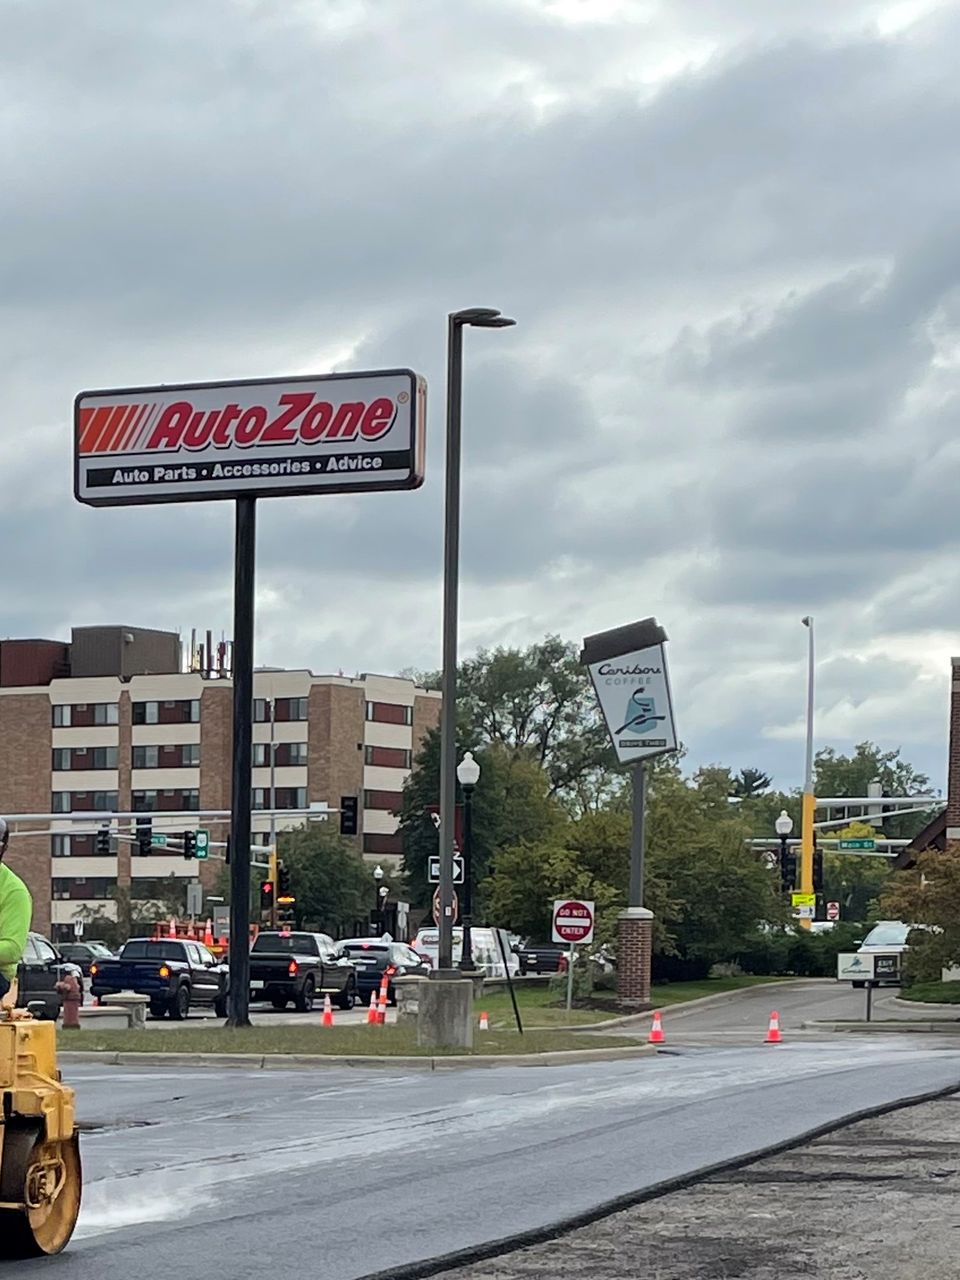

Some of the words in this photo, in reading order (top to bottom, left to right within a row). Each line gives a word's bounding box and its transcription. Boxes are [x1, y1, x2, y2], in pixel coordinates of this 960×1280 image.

[145, 391, 395, 450] AutoZone
[112, 469, 150, 484] Auto
[154, 466, 197, 481] Parts
[212, 459, 310, 478] Accessories
[326, 456, 383, 472] Advice
[598, 663, 662, 676] Caribou
[605, 677, 653, 686] COFFEE
[572, 909, 588, 917] NOT
[561, 927, 584, 935] ENTER
